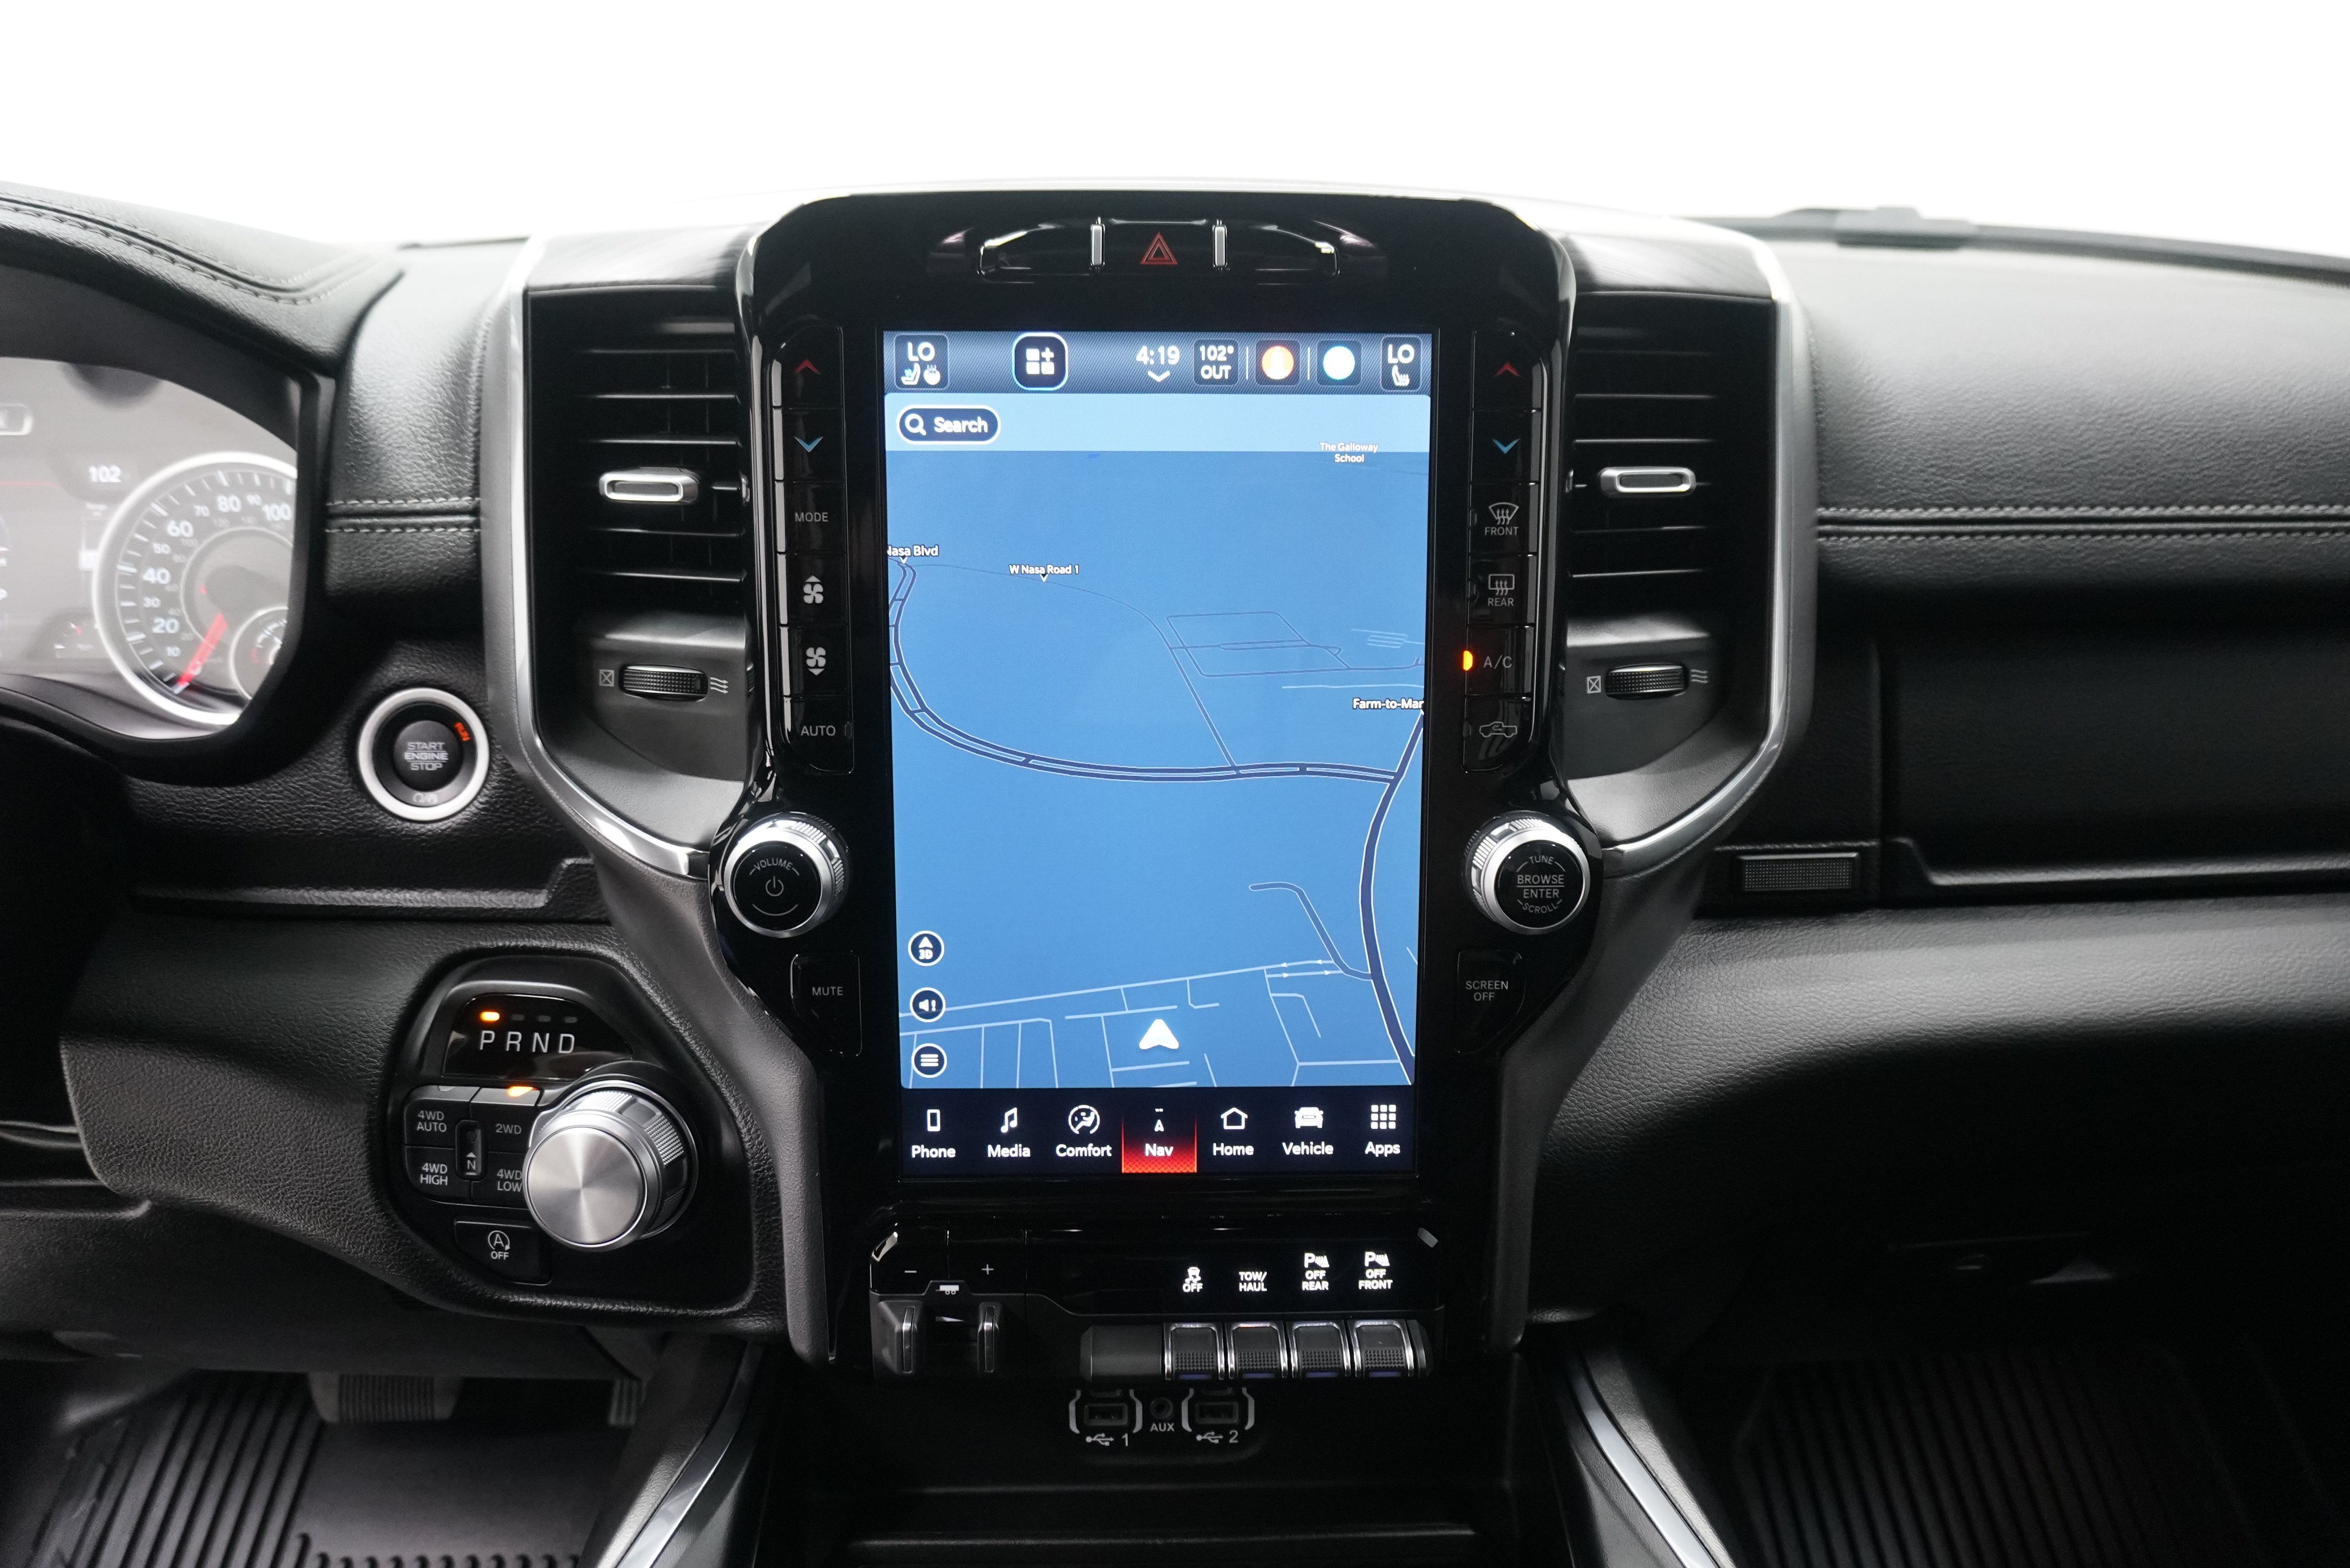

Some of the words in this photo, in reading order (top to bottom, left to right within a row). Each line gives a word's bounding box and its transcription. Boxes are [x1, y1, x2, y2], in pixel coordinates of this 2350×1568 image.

[907, 342, 935, 362] LO
[1136, 345, 1180, 365] 4:19
[1387, 344, 1415, 363] LO
[1200, 365, 1232, 380] OUT
[934, 416, 988, 433] Search
[1320, 442, 1336, 452] The
[1338, 442, 1378, 453] Galloway
[1335, 453, 1364, 463] School
[89, 464, 122, 483] 102
[216, 495, 241, 513] 80
[193, 504, 210, 517] 70
[262, 503, 292, 521] 100
[795, 512, 828, 523] MODE
[166, 520, 194, 538] 60
[1485, 527, 1519, 536] FRONT
[153, 543, 171, 554] 50
[914, 545, 938, 556] Blvd
[1009, 565, 1019, 574] W
[1021, 565, 1045, 574] Nasa
[1047, 564, 1072, 574] Road
[1075, 565, 1079, 574] 1
[143, 568, 171, 584] 40
[143, 597, 161, 608] 30
[1488, 598, 1514, 607] REAR
[152, 618, 180, 634] 20
[166, 646, 181, 657] 10
[1483, 655, 1512, 669] A/C
[800, 725, 836, 736] AUTO
[407, 742, 445, 750] START
[404, 752, 448, 760] ENGINE
[410, 763, 443, 771] STOP
[753, 858, 793, 871] VOLUME
[1529, 855, 1554, 864] TUNE
[1517, 874, 1564, 885] BROWSE
[1523, 889, 1559, 899] ENTER
[1522, 902, 1558, 914] SCROLL
[919, 949, 933, 960] 3D
[1466, 980, 1509, 990] SCREEN
[812, 986, 844, 996] MUTE
[1474, 992, 1495, 1001] OFF
[417, 1110, 444, 1121] 4WD
[417, 1121, 447, 1132] AUTO
[496, 1123, 522, 1135] 2WD
[911, 1144, 956, 1158] Phone
[987, 1143, 1031, 1157] Media
[1055, 1143, 1112, 1157] Comfort
[1145, 1143, 1174, 1157] Nav
[1213, 1142, 1254, 1156] Home
[1282, 1141, 1334, 1155] Vehicle
[1365, 1141, 1401, 1157] Apps
[422, 1162, 448, 1174] 4WD
[467, 1160, 476, 1170] N
[420, 1174, 448, 1186] HIGH
[497, 1169, 523, 1180] 4WD
[497, 1181, 523, 1192] LOW
[491, 1251, 509, 1260] OFF
[1239, 1271, 1267, 1282] TOW/
[1305, 1270, 1326, 1280] OFF
[1365, 1268, 1386, 1279] OFF
[1182, 1282, 1203, 1292] OFF
[1239, 1282, 1267, 1292] HAUL
[1302, 1281, 1329, 1291] REAR
[1358, 1279, 1393, 1290] FRONT
[1150, 1422, 1175, 1432] AUX
[1122, 1433, 1129, 1447] 1
[1229, 1430, 1239, 1443] 2
